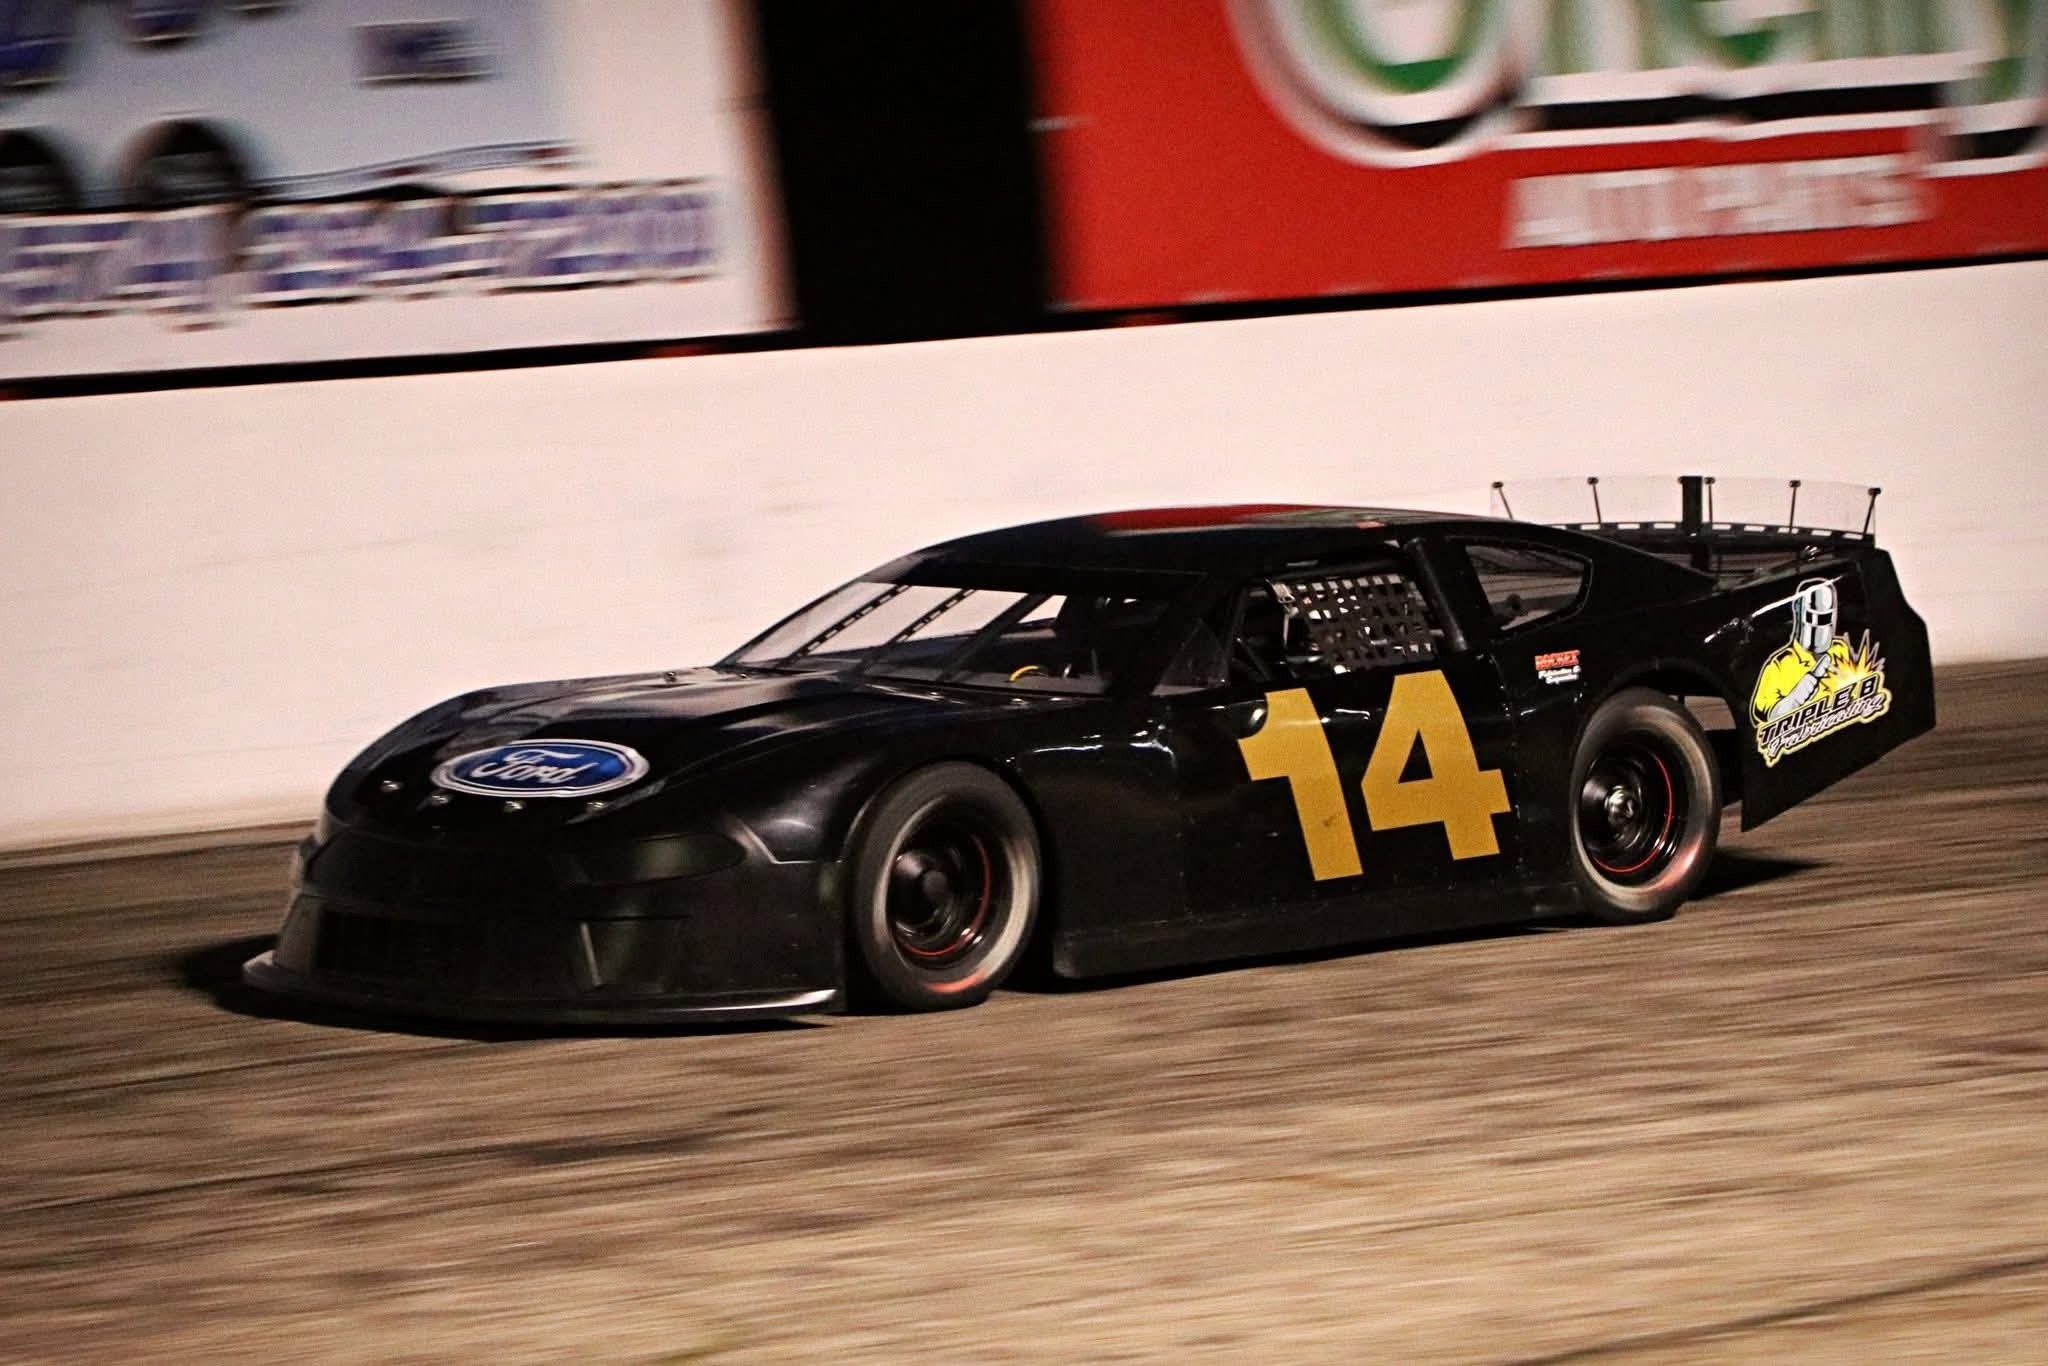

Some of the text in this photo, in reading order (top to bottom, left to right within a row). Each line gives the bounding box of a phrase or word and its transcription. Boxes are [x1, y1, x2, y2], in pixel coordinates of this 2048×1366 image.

[1760, 674, 1879, 746] TRIPLE B
[470, 748, 599, 784] Ford
[1238, 669, 1511, 881] 14
